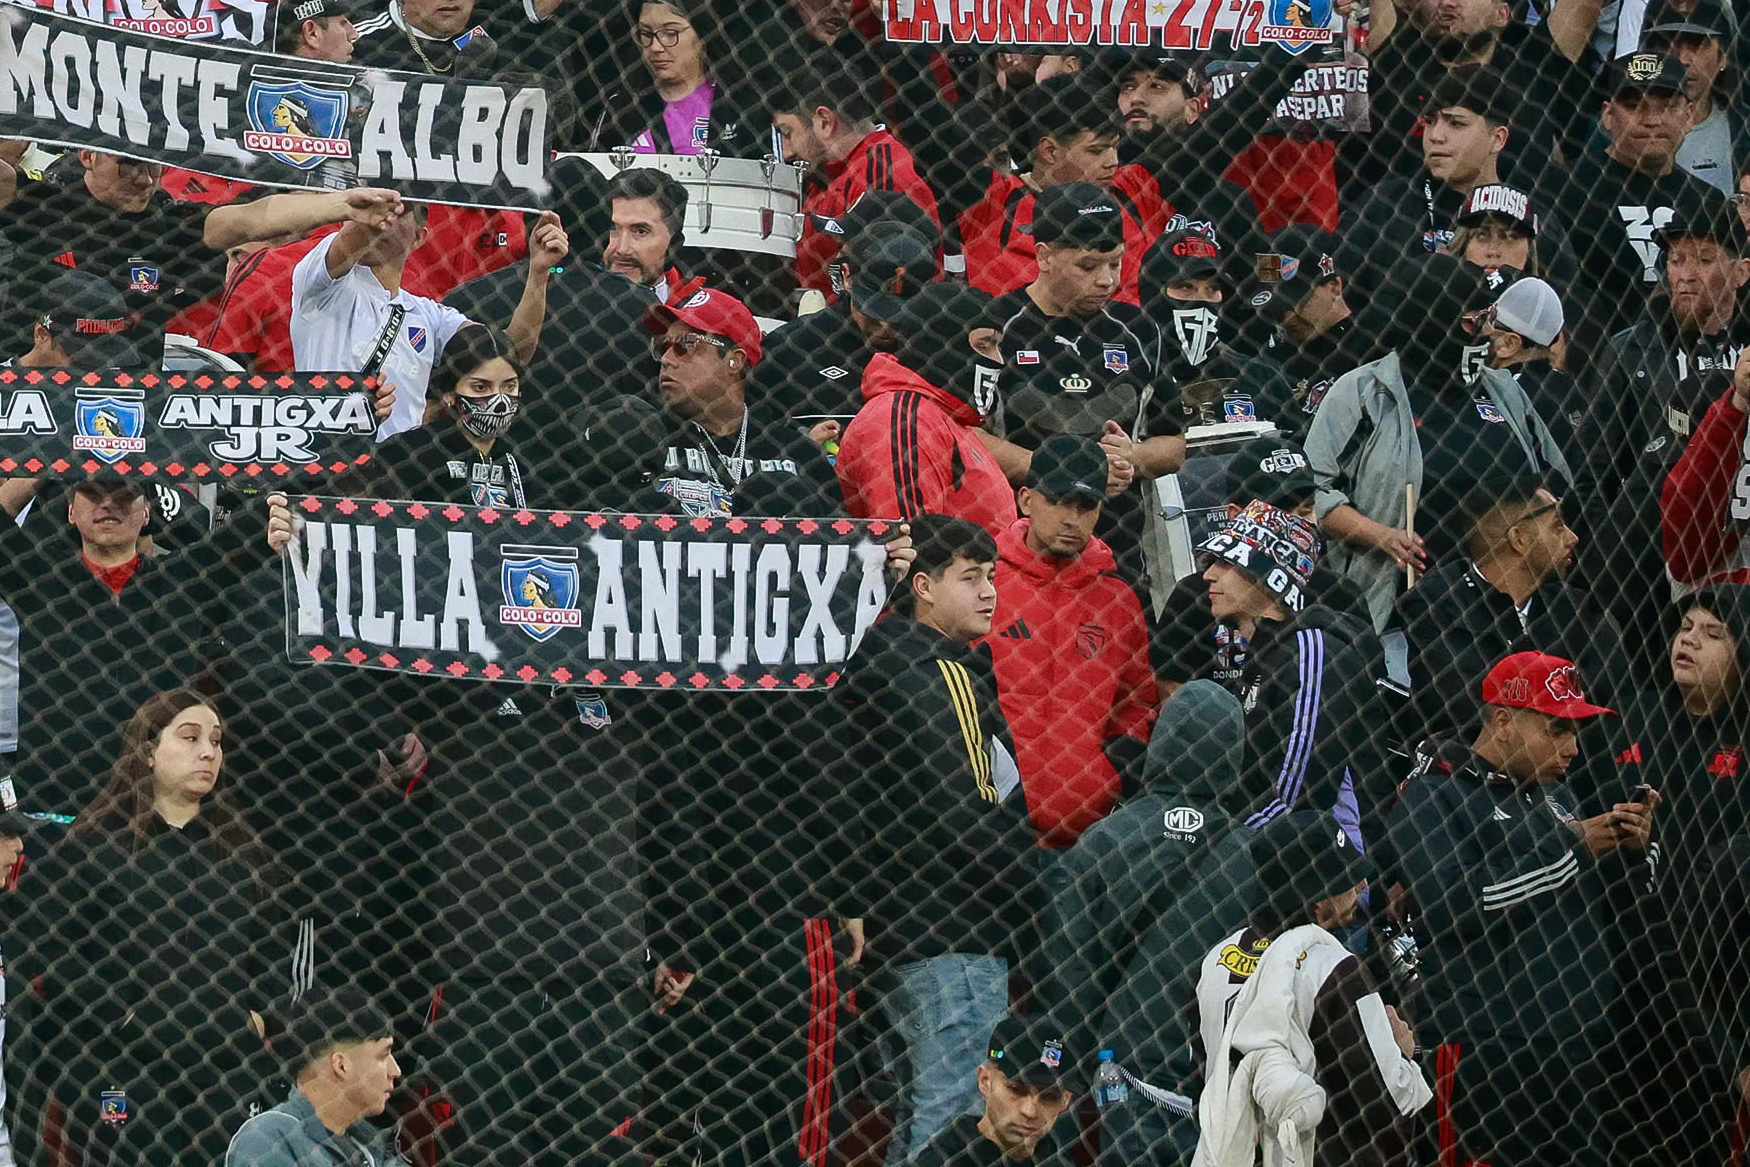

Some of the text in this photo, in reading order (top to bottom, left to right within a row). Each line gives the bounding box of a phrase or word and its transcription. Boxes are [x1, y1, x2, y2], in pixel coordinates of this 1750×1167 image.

[1263, 27, 1332, 42] COLO-COLO
[1636, 60, 1656, 74] 100
[246, 134, 351, 155] COLO-COLO
[358, 78, 547, 192] ALBO
[1470, 185, 1528, 221] ACIDOSIS
[162, 395, 373, 432] ANTIGXA
[75, 437, 145, 451] COLO-COLO
[210, 427, 318, 463] JR
[289, 521, 892, 666] VILLA ANTIGXA
[502, 608, 581, 625] COLO-COLO
[1168, 810, 1200, 829] MG
